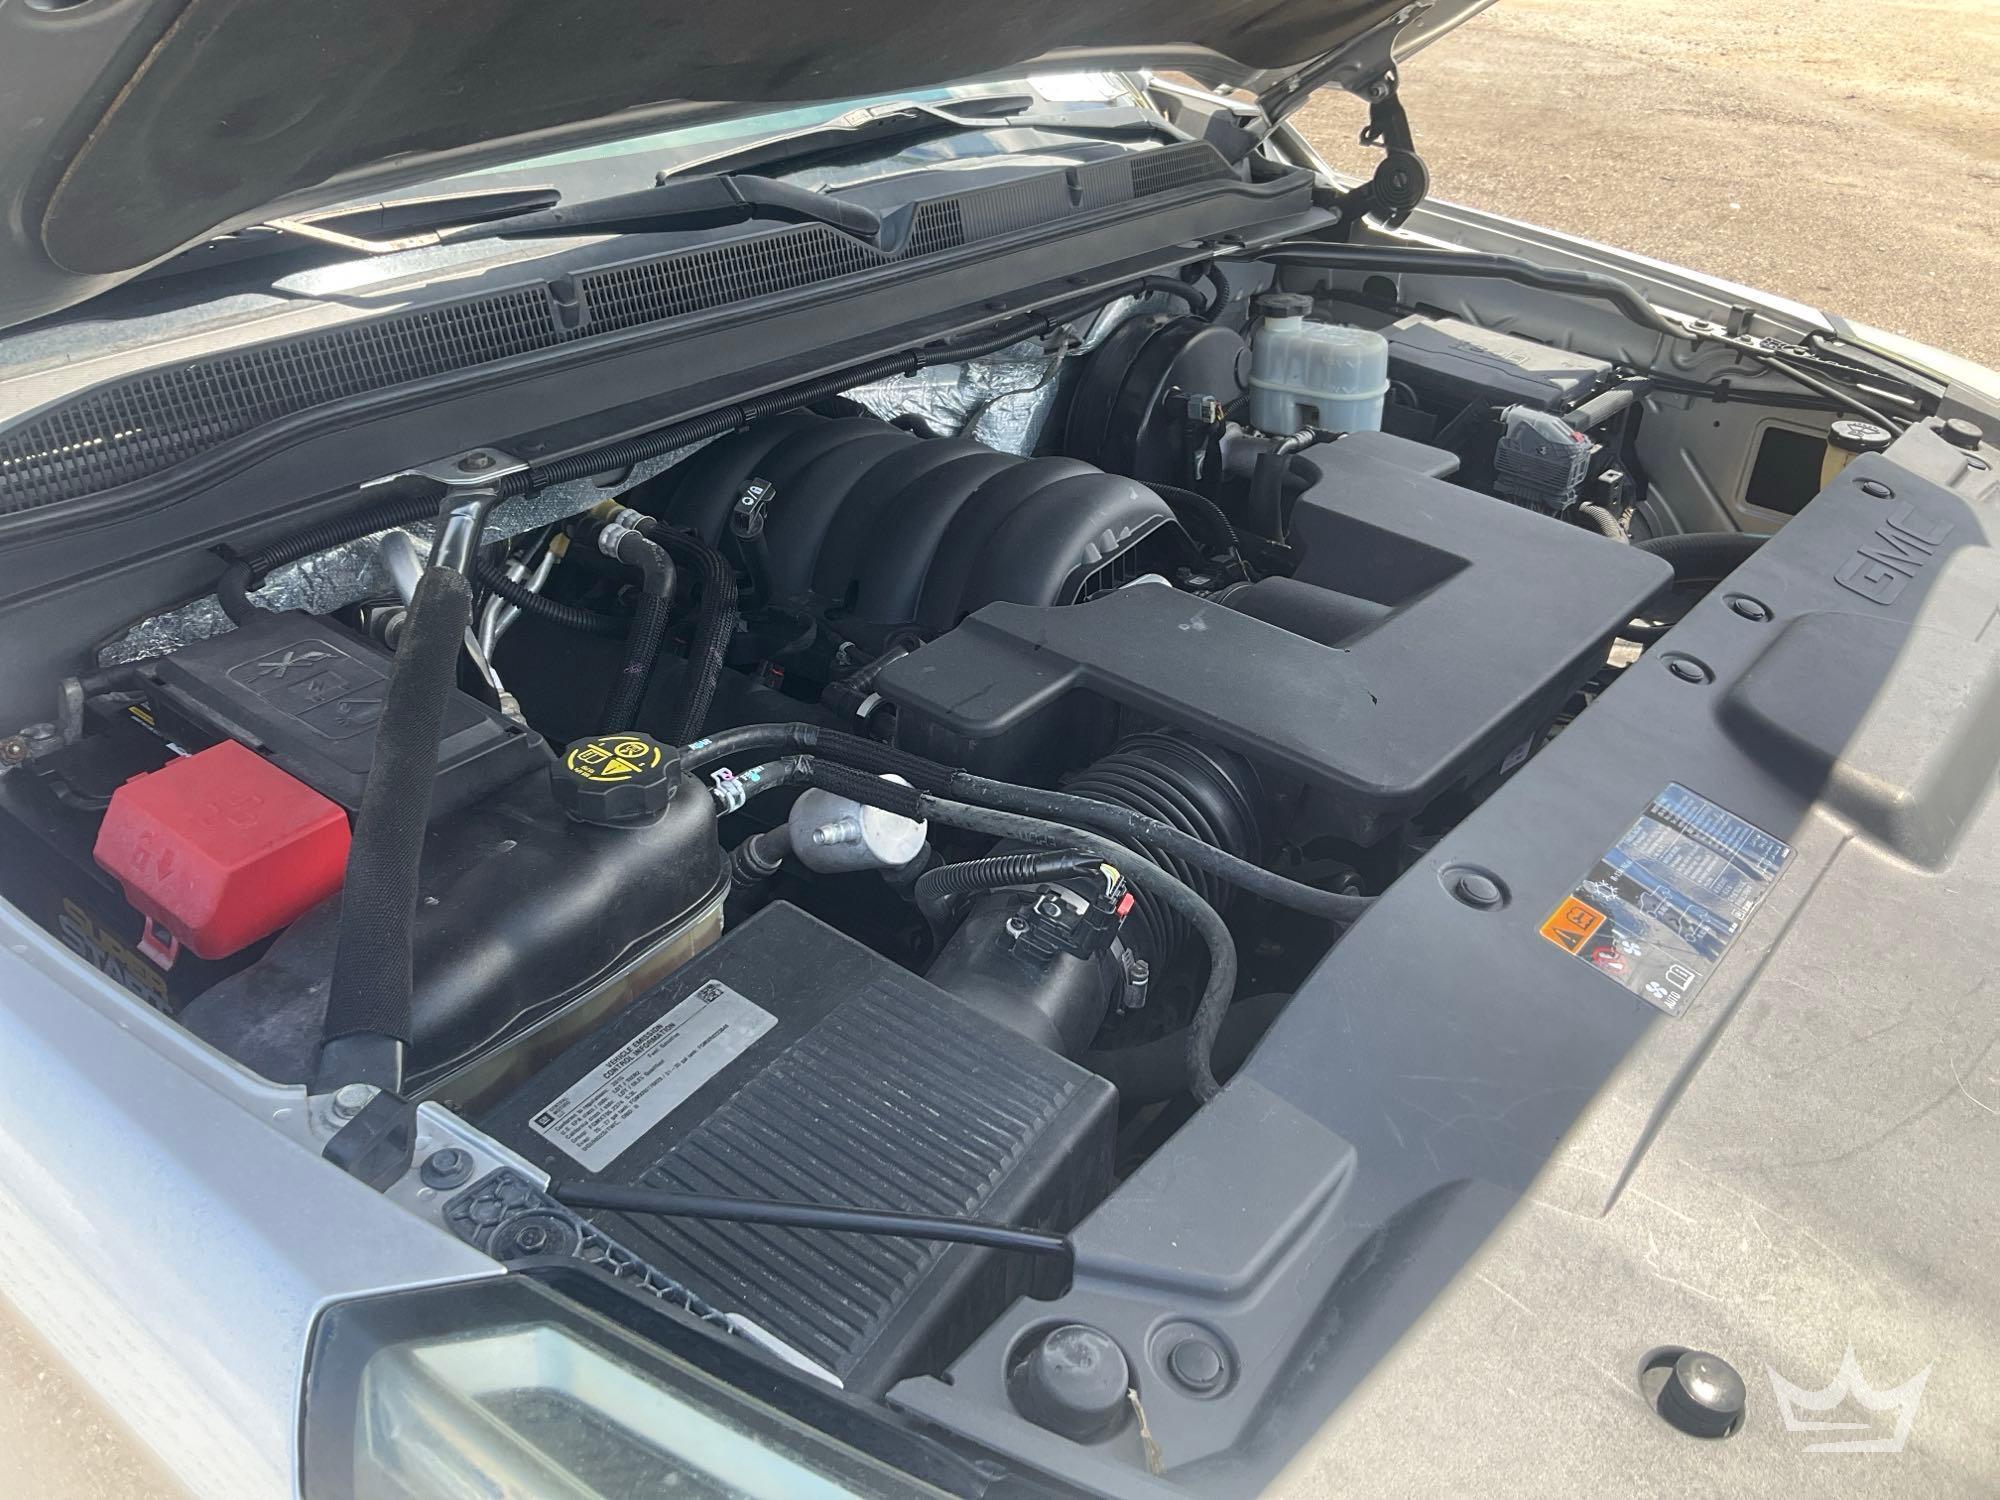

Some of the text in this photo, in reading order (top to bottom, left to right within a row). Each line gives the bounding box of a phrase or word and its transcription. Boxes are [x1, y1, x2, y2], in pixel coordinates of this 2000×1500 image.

[1833, 502, 1954, 606] GMC
[62, 897, 169, 1005] SUPER
[1663, 990, 1681, 1010] AUTO
[601, 1021, 676, 1080] CONTROL INFORMATION
[604, 1022, 663, 1068] VEHICLE EMISSION
